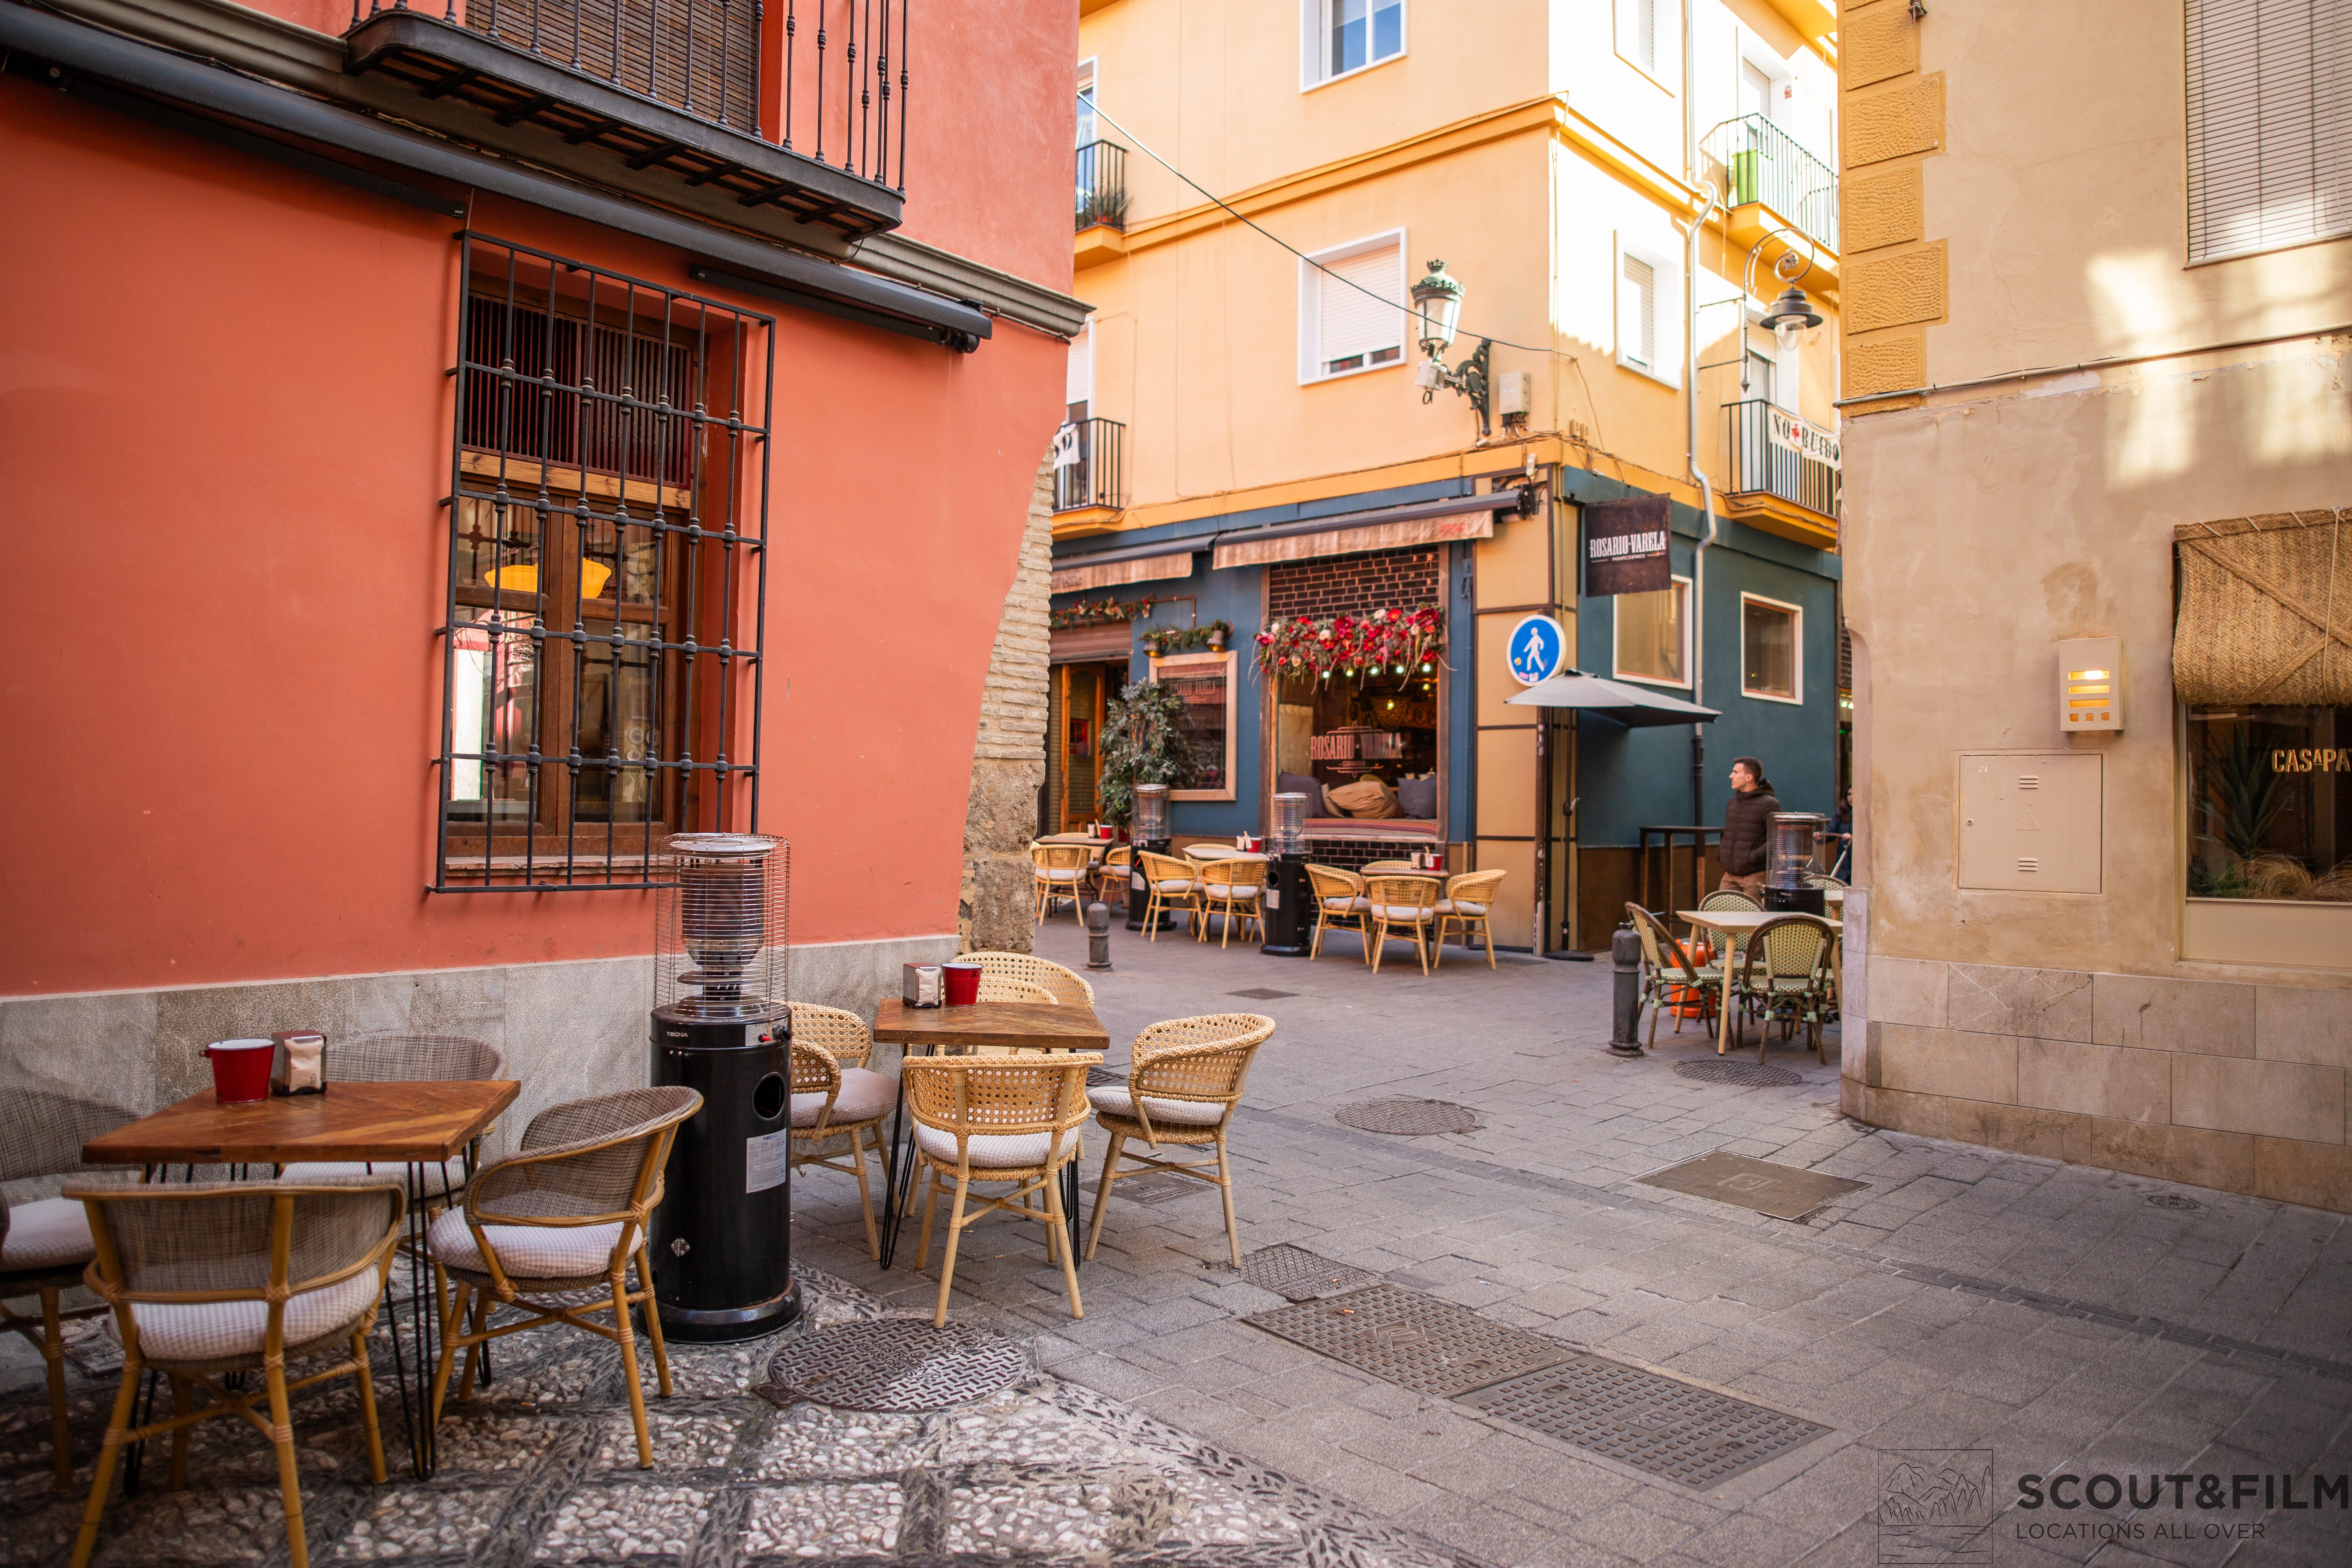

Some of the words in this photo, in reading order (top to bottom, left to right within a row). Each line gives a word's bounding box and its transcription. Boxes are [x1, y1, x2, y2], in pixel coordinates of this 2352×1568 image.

[1774, 414, 1790, 439] NO
[1802, 427, 1839, 462] RUIDO
[1195, 680, 1216, 695] VARELA
[1310, 735, 1355, 760] ROSARIO
[1361, 732, 1403, 759] VARELA
